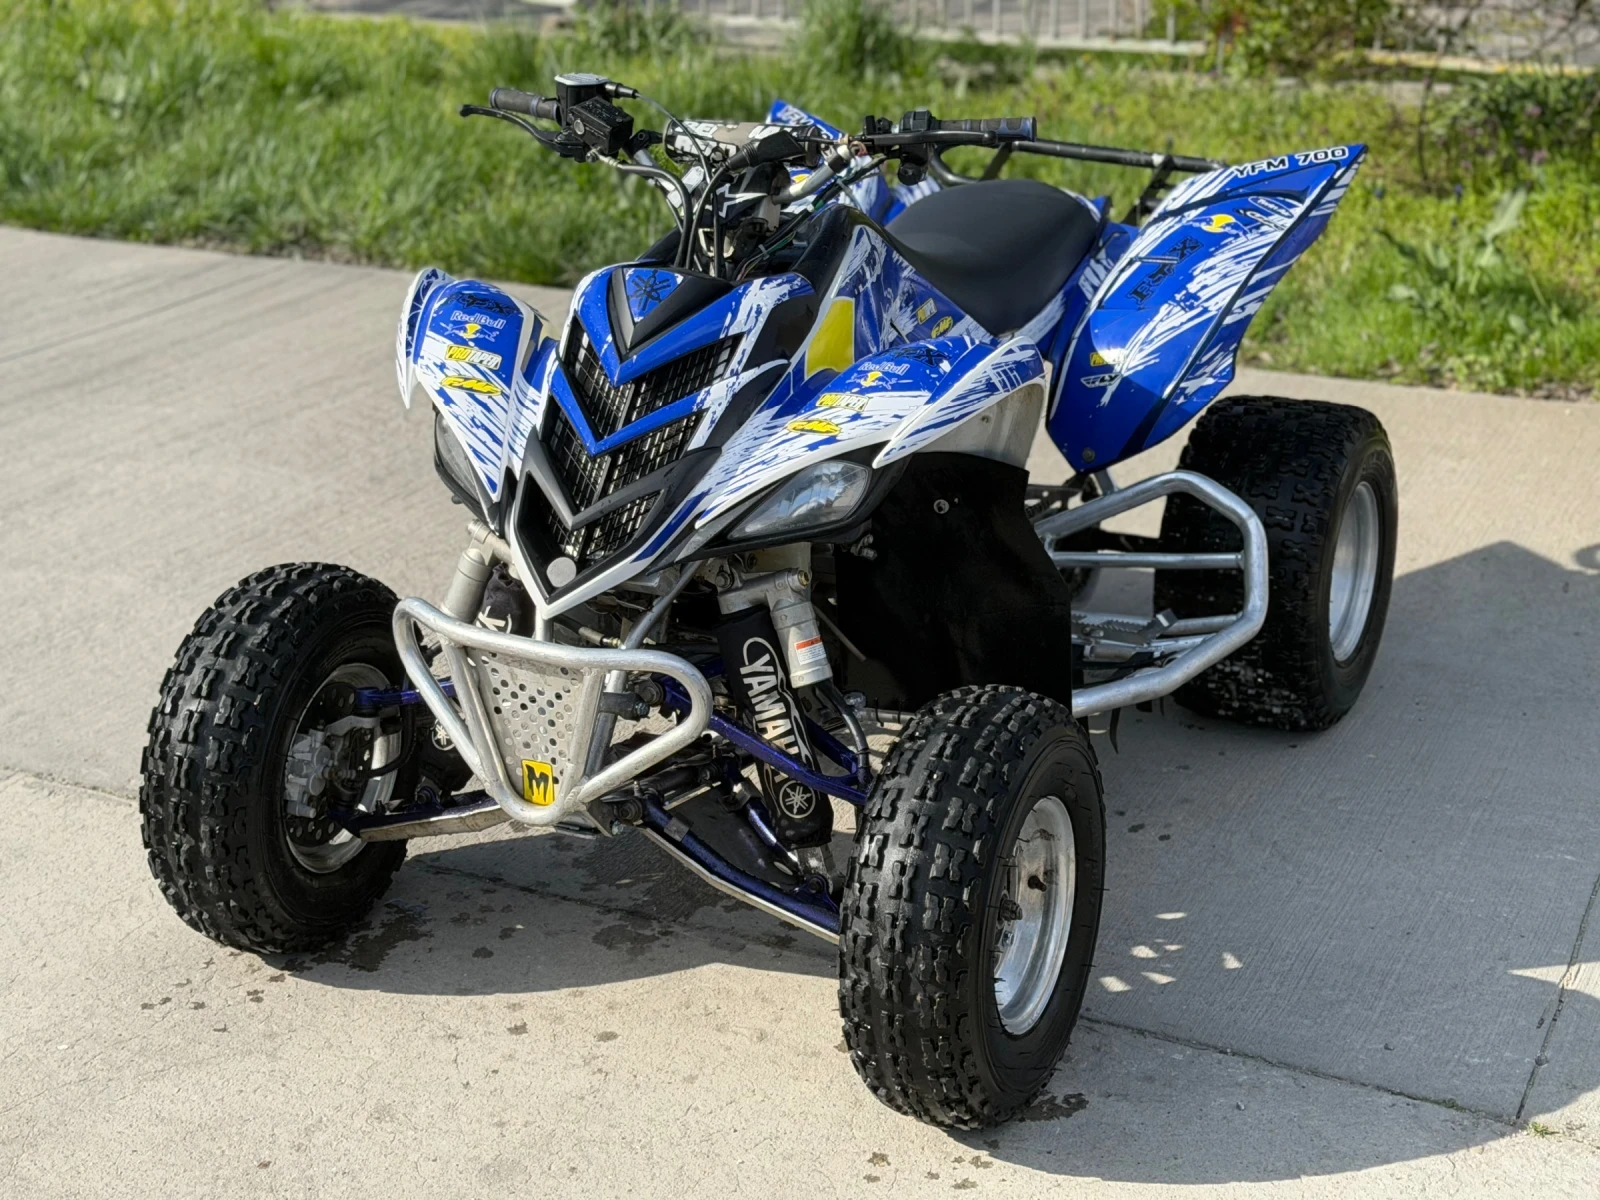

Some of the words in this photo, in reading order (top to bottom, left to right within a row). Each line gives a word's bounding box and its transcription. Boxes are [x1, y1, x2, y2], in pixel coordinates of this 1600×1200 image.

[1233, 159, 1288, 178] YFM
[1295, 146, 1349, 165] 700
[739, 653, 806, 783] YAMAH
[525, 764, 550, 803] M
